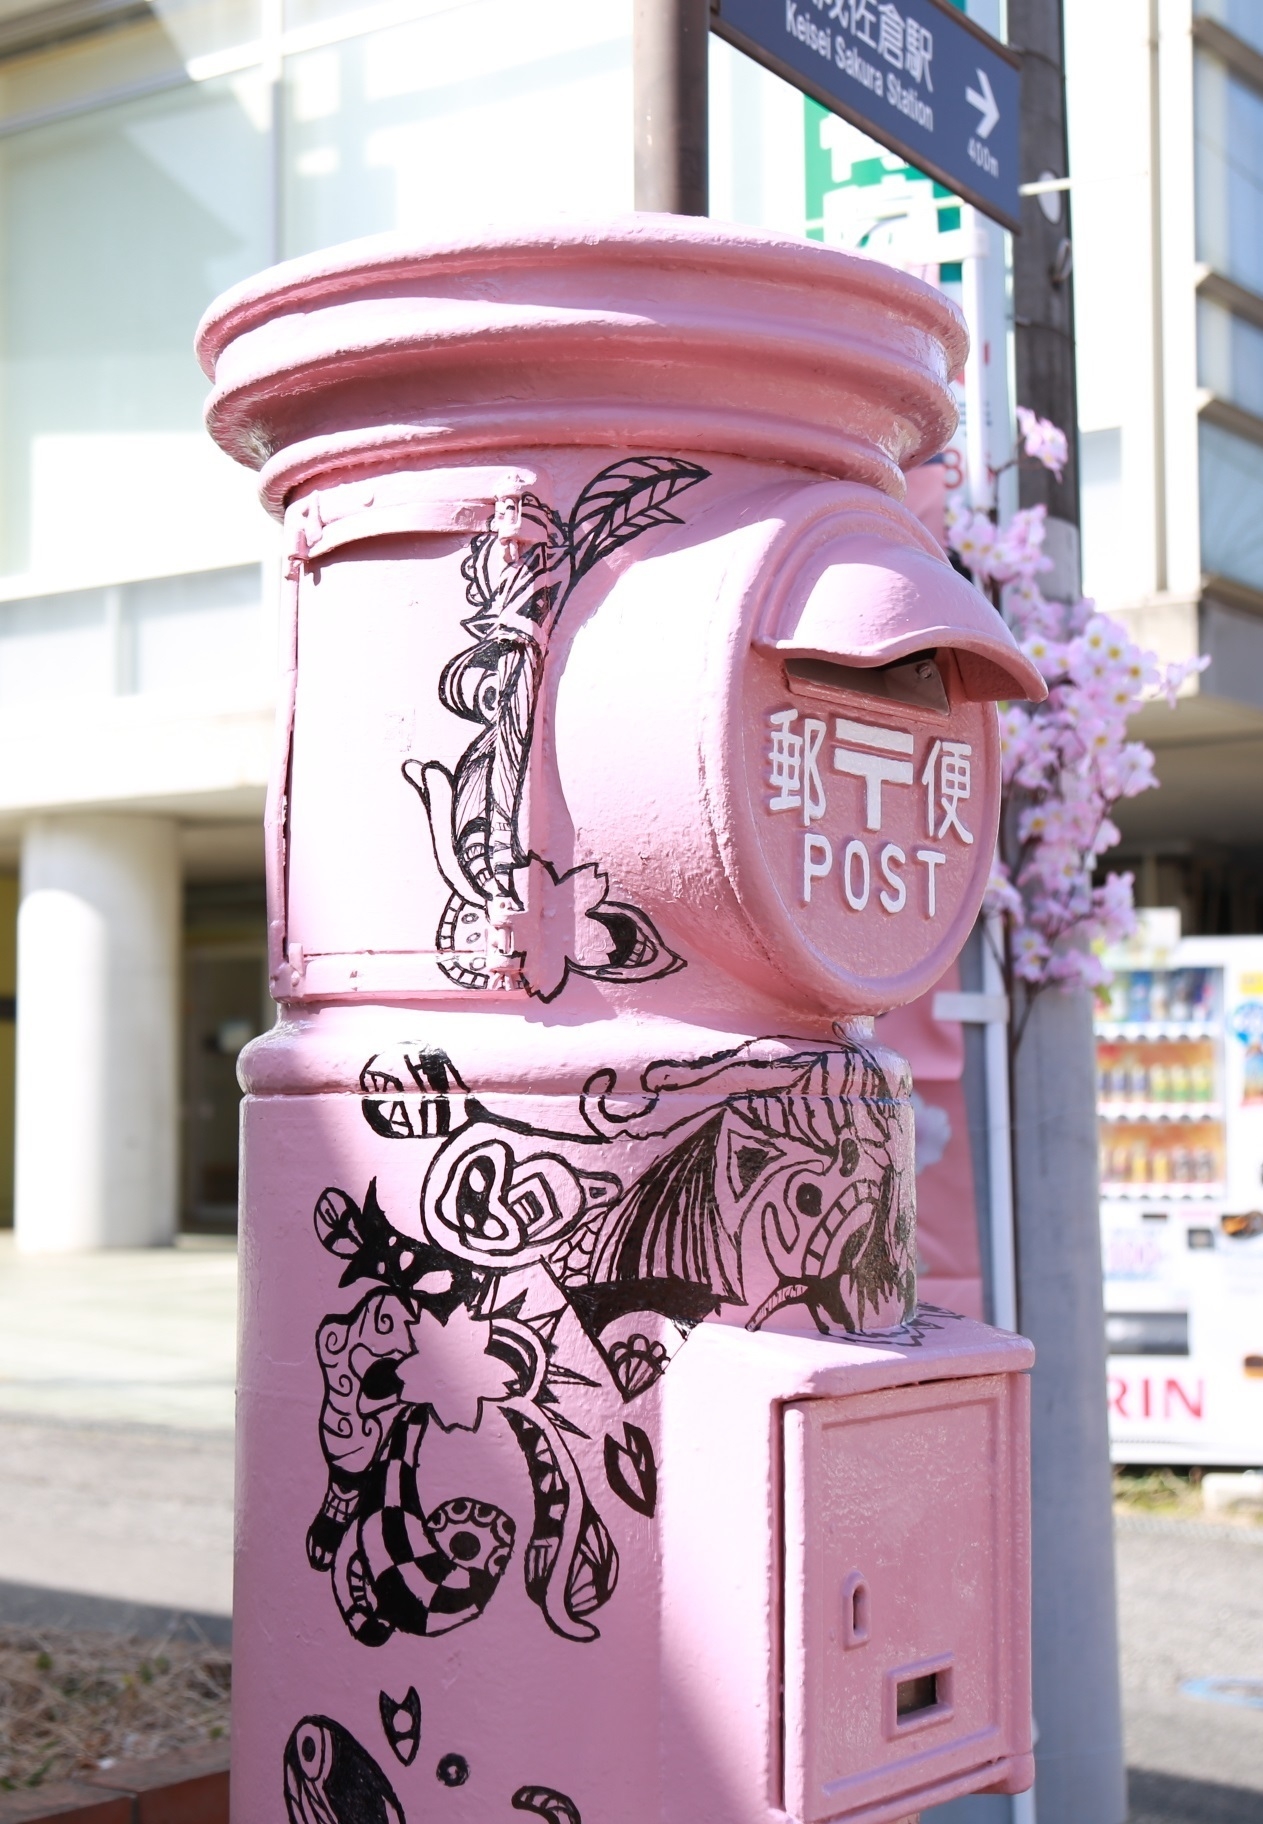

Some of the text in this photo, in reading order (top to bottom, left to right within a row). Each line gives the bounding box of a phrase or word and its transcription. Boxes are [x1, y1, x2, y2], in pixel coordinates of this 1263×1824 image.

[785, 0, 933, 132] Keisei Sakura Station
[967, 137, 999, 178] 400m
[804, 833, 945, 917] POST
